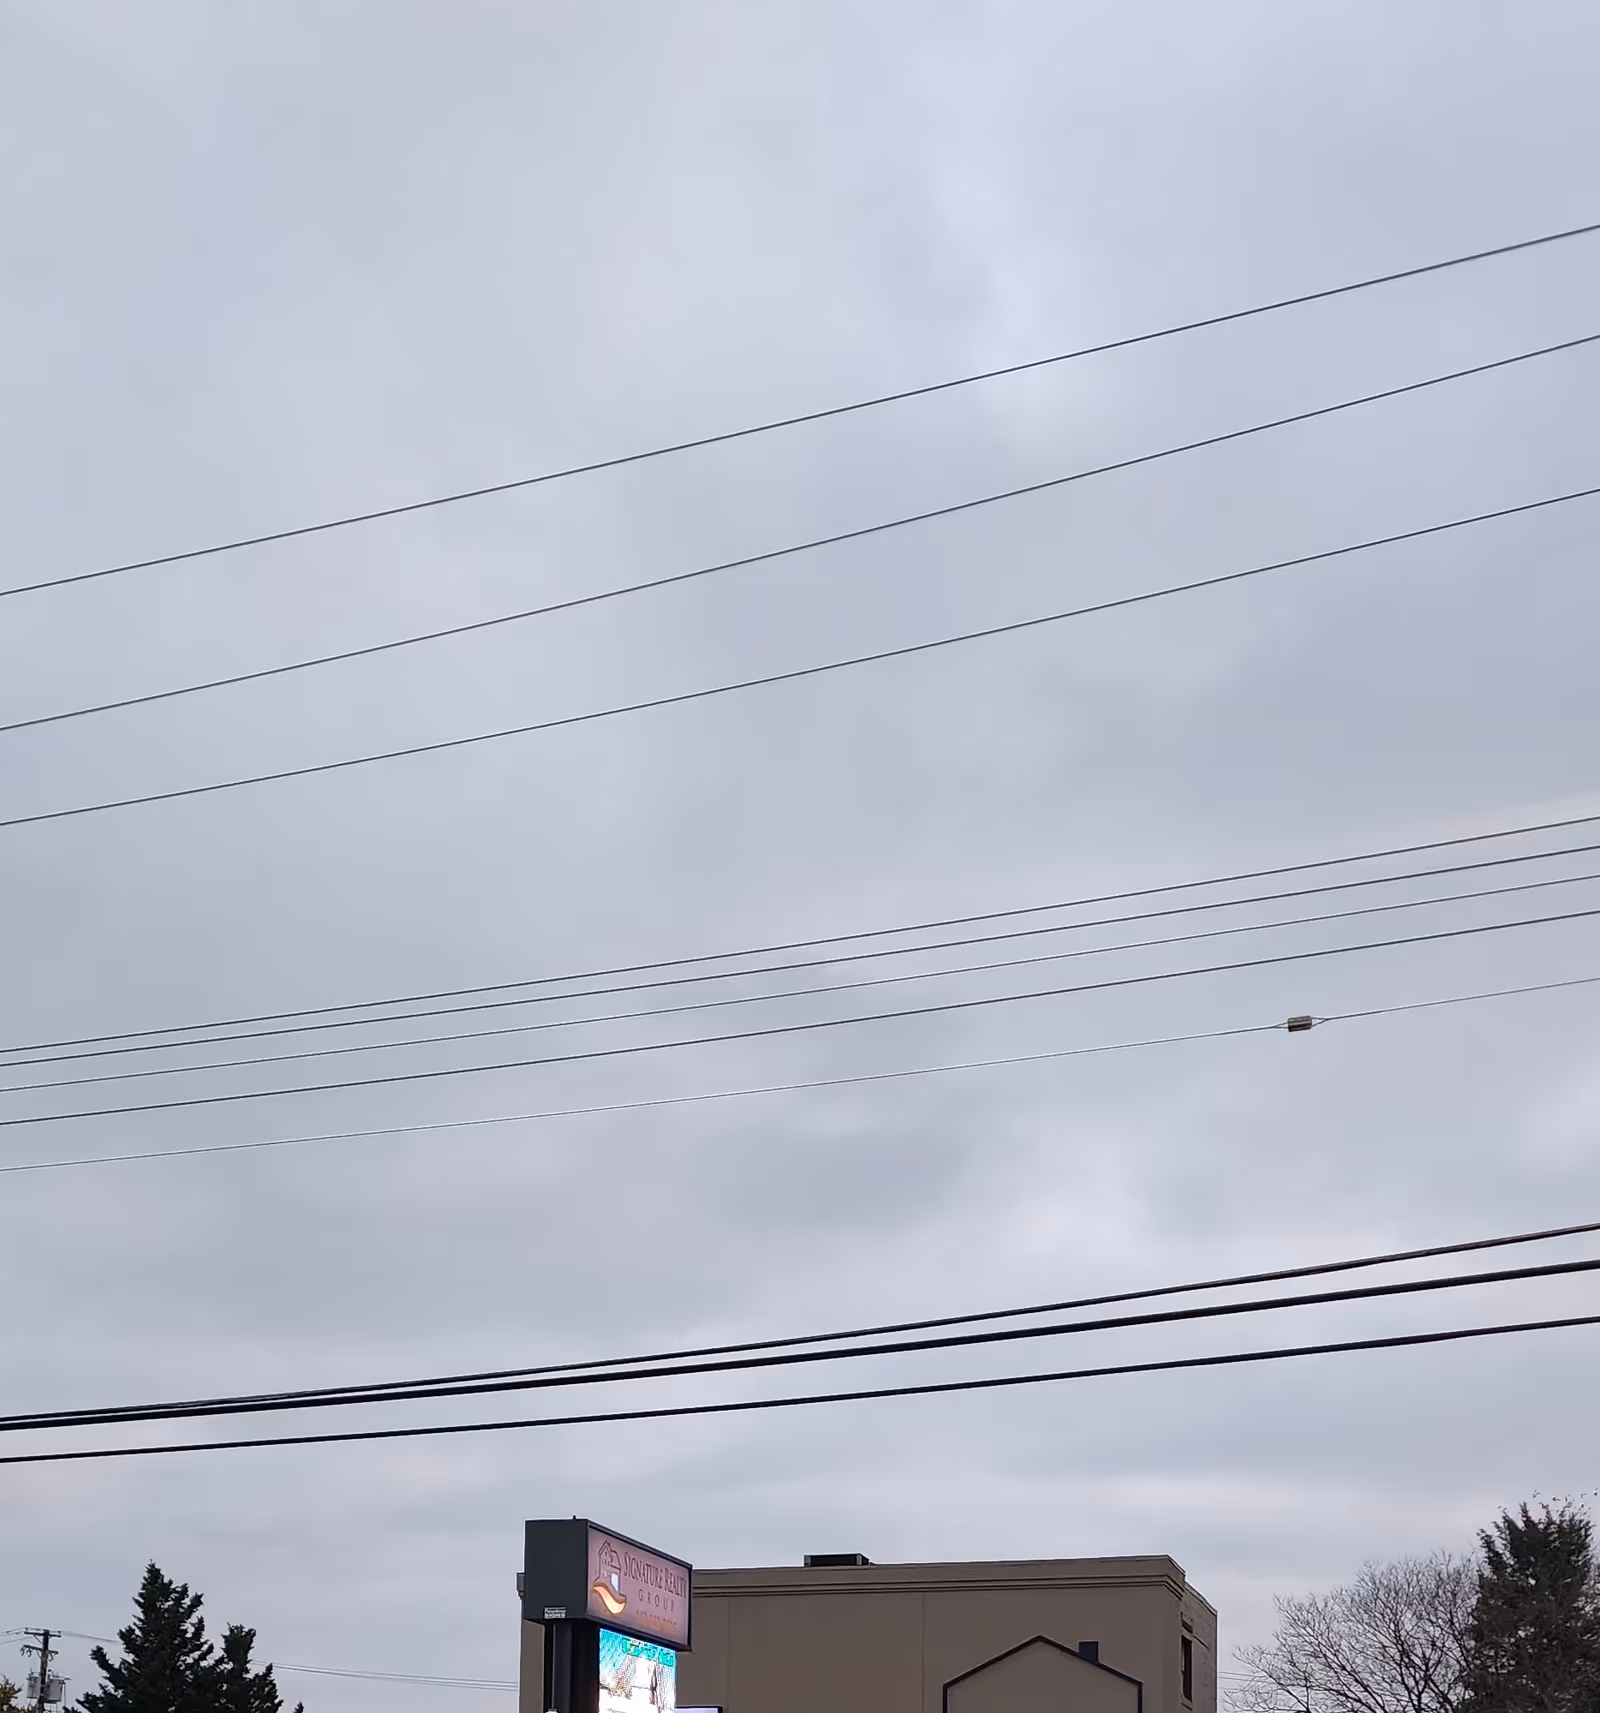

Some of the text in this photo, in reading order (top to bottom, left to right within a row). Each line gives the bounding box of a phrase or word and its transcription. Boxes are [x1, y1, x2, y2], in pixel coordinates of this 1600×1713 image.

[623, 1551, 687, 1599] SIGNATURE REALTY
[638, 1588, 674, 1612] GROUP
